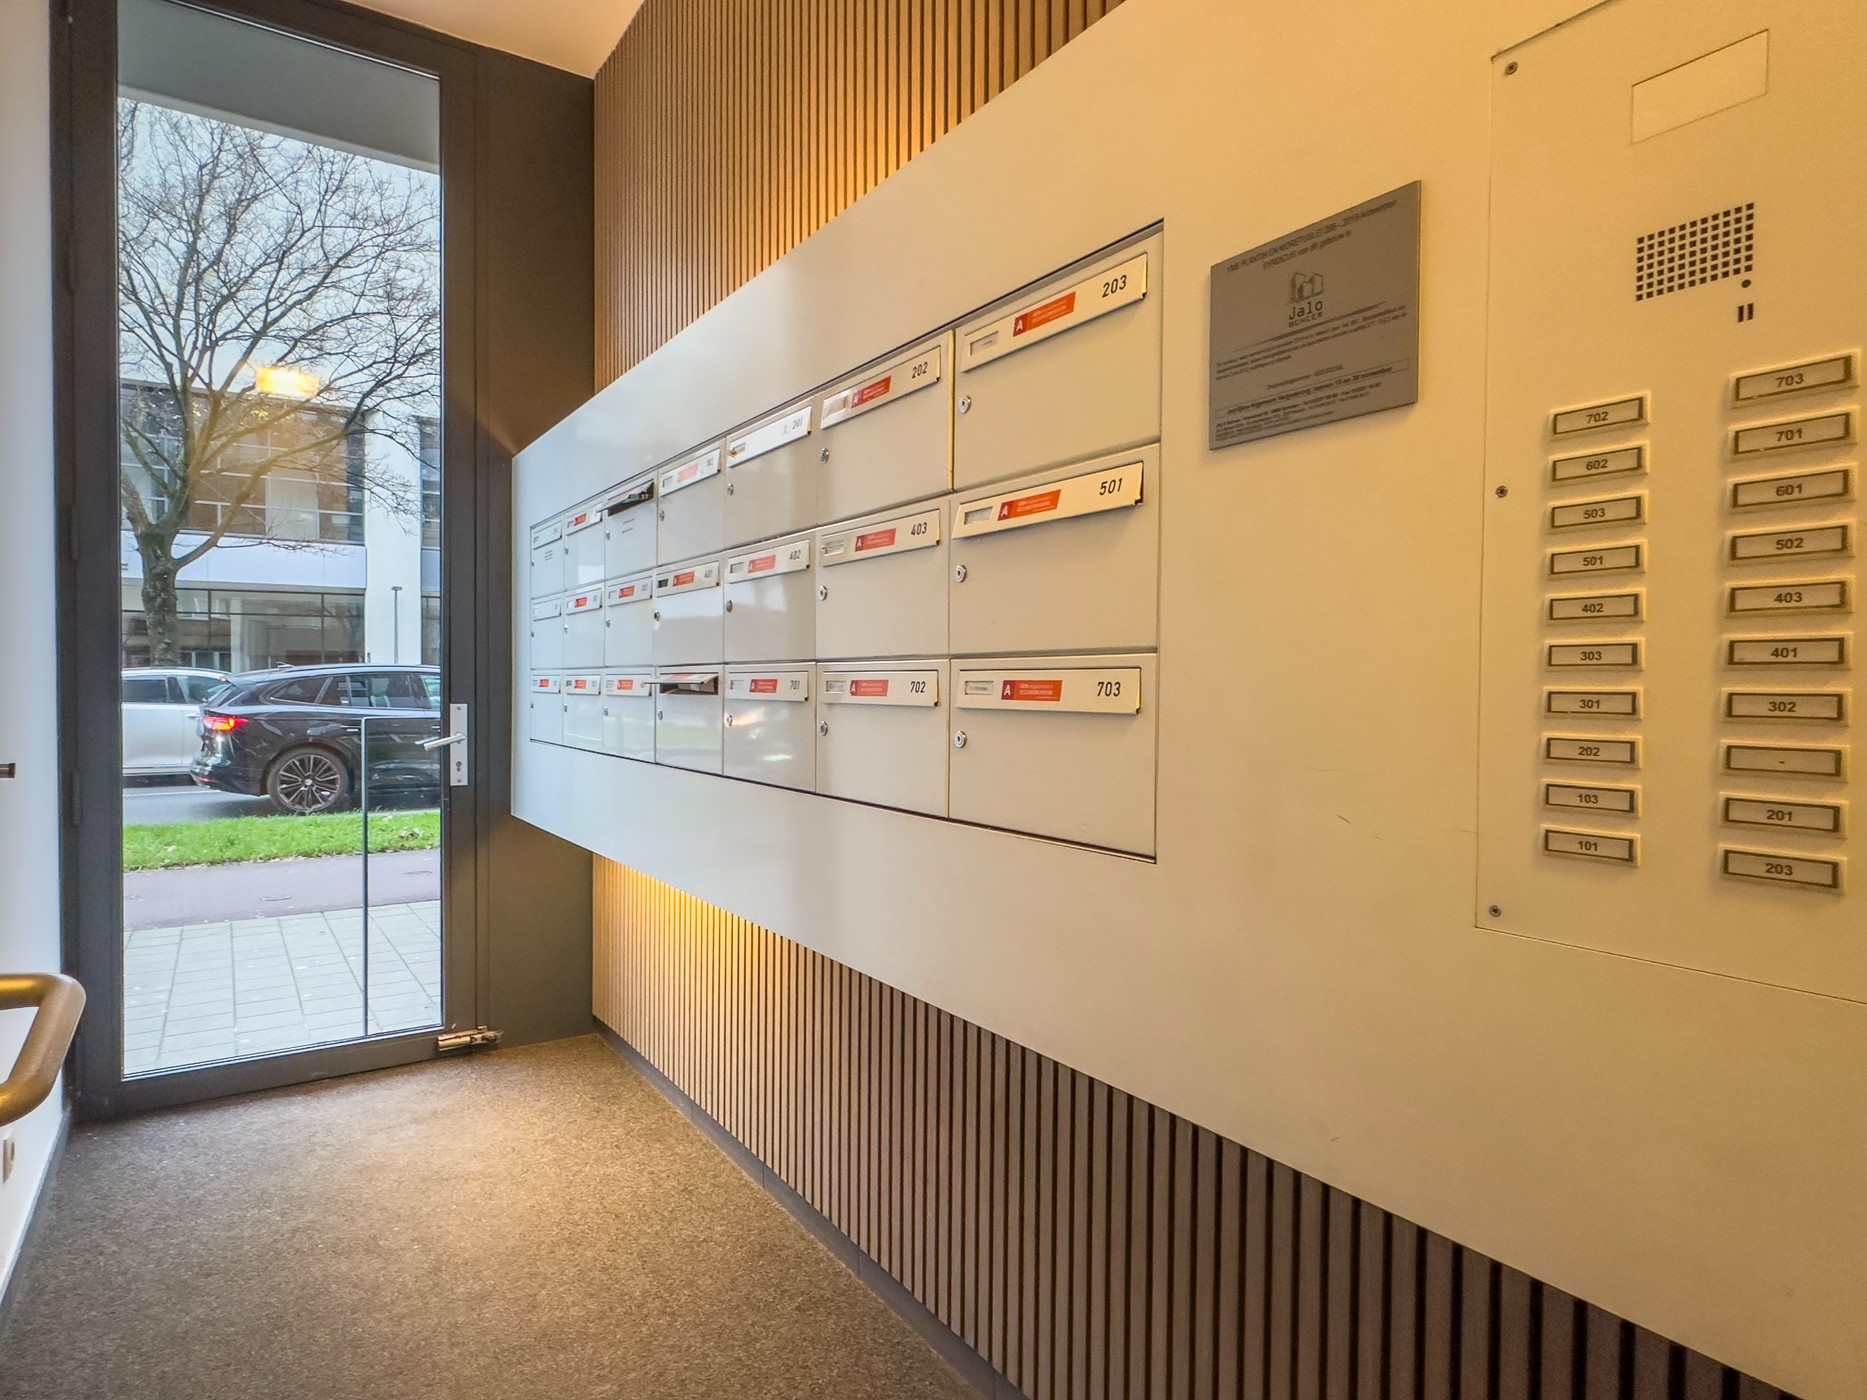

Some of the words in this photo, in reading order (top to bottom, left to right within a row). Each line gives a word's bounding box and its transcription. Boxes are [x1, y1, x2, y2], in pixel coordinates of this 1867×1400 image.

[1102, 274, 1127, 298] 203
[1288, 299, 1322, 320] Jalo
[1015, 319, 1024, 331] A
[912, 362, 927, 378] 202
[1775, 372, 1804, 388] 703
[1585, 411, 1608, 424] 702
[1775, 428, 1803, 442] 701
[1586, 459, 1607, 470] 602
[1099, 477, 1123, 496] 501
[1775, 482, 1804, 496] 601
[1001, 505, 1008, 517] A
[1584, 508, 1605, 519] 503
[911, 522, 927, 535] 403
[1775, 535, 1804, 551] 502
[789, 549, 801, 560] 402
[1583, 556, 1603, 566] 501
[1775, 592, 1802, 603] 403
[1582, 603, 1603, 613] 402
[1581, 651, 1601, 660] 303
[1771, 648, 1797, 658] 401
[791, 680, 800, 689] 701
[911, 681, 925, 693] 702
[1003, 684, 1012, 696] A
[1097, 681, 1121, 697] 703
[1580, 699, 1599, 708] 301
[1769, 702, 1796, 712] 302
[1579, 747, 1599, 756] 202
[1578, 794, 1598, 804] 103
[1767, 810, 1792, 821] 201
[1578, 841, 1597, 851] 101
[1766, 863, 1793, 875] 203
